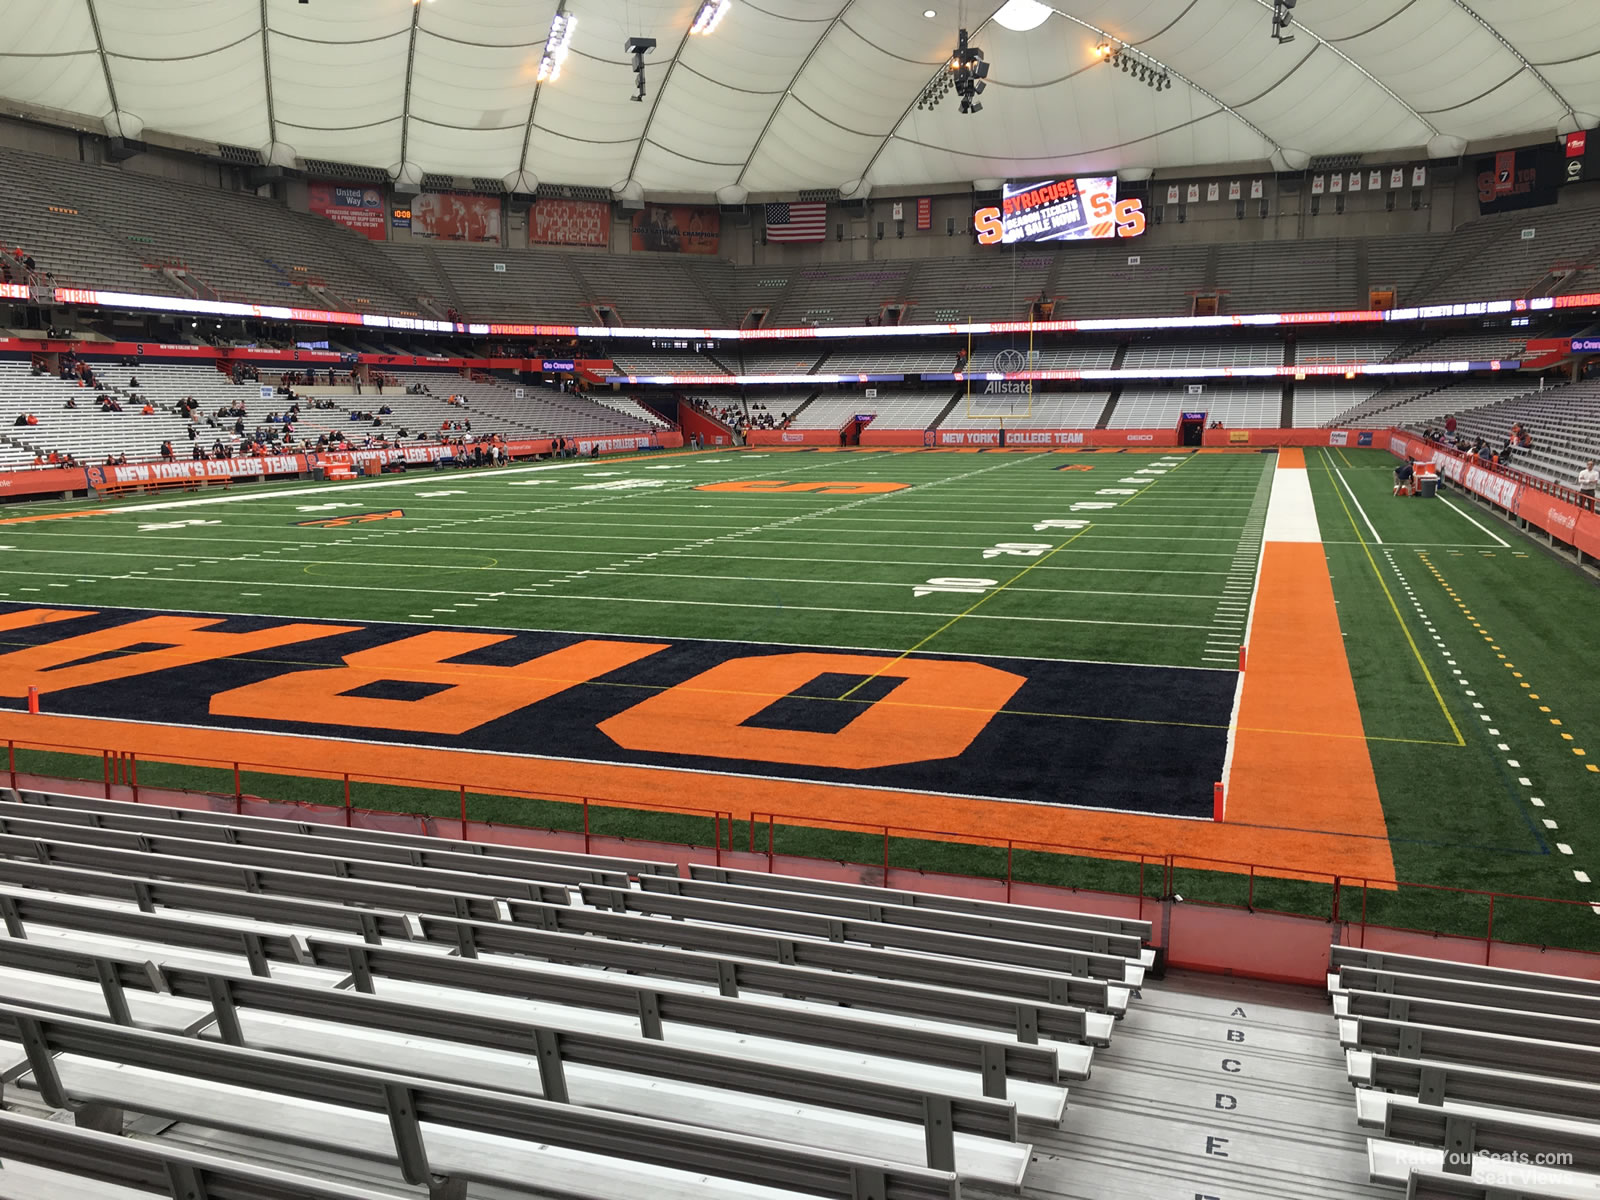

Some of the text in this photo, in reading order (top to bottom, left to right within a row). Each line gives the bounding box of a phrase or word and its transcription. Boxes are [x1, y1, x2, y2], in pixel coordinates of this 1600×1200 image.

[1500, 171, 1509, 182] 7
[336, 188, 361, 198] United
[1003, 178, 1077, 215] SYRACUSE
[346, 197, 361, 206] Way
[1090, 192, 1113, 218] S
[394, 210, 411, 219] 10:08
[1006, 199, 1079, 229] SEASON TICKETS
[1115, 198, 1146, 238] S
[974, 207, 1003, 245] S
[1008, 226, 1025, 242] ON
[1025, 218, 1051, 236] SALE
[491, 324, 535, 334] SYRACUSE
[536, 325, 577, 336] FOOTBALL
[1572, 341, 1582, 350] Go
[984, 381, 1033, 395] Allstate
[612, 438, 635, 450] COLLEGE
[635, 436, 649, 448] TEAM
[942, 433, 966, 443] NEW
[1006, 433, 1052, 443] COLLEGE
[1054, 433, 1083, 443] TEAM
[388, 448, 429, 464] COLEGE
[429, 447, 451, 460] TEAM
[113, 454, 298, 483] NEW YORK'S COLLEGE TEAM
[912, 577, 999, 594] 10
[1231, 1007, 1247, 1019] A
[1226, 1029, 1246, 1043] B
[1221, 1059, 1242, 1073] C
[1215, 1093, 1238, 1111] D
[1205, 1136, 1229, 1158] E
